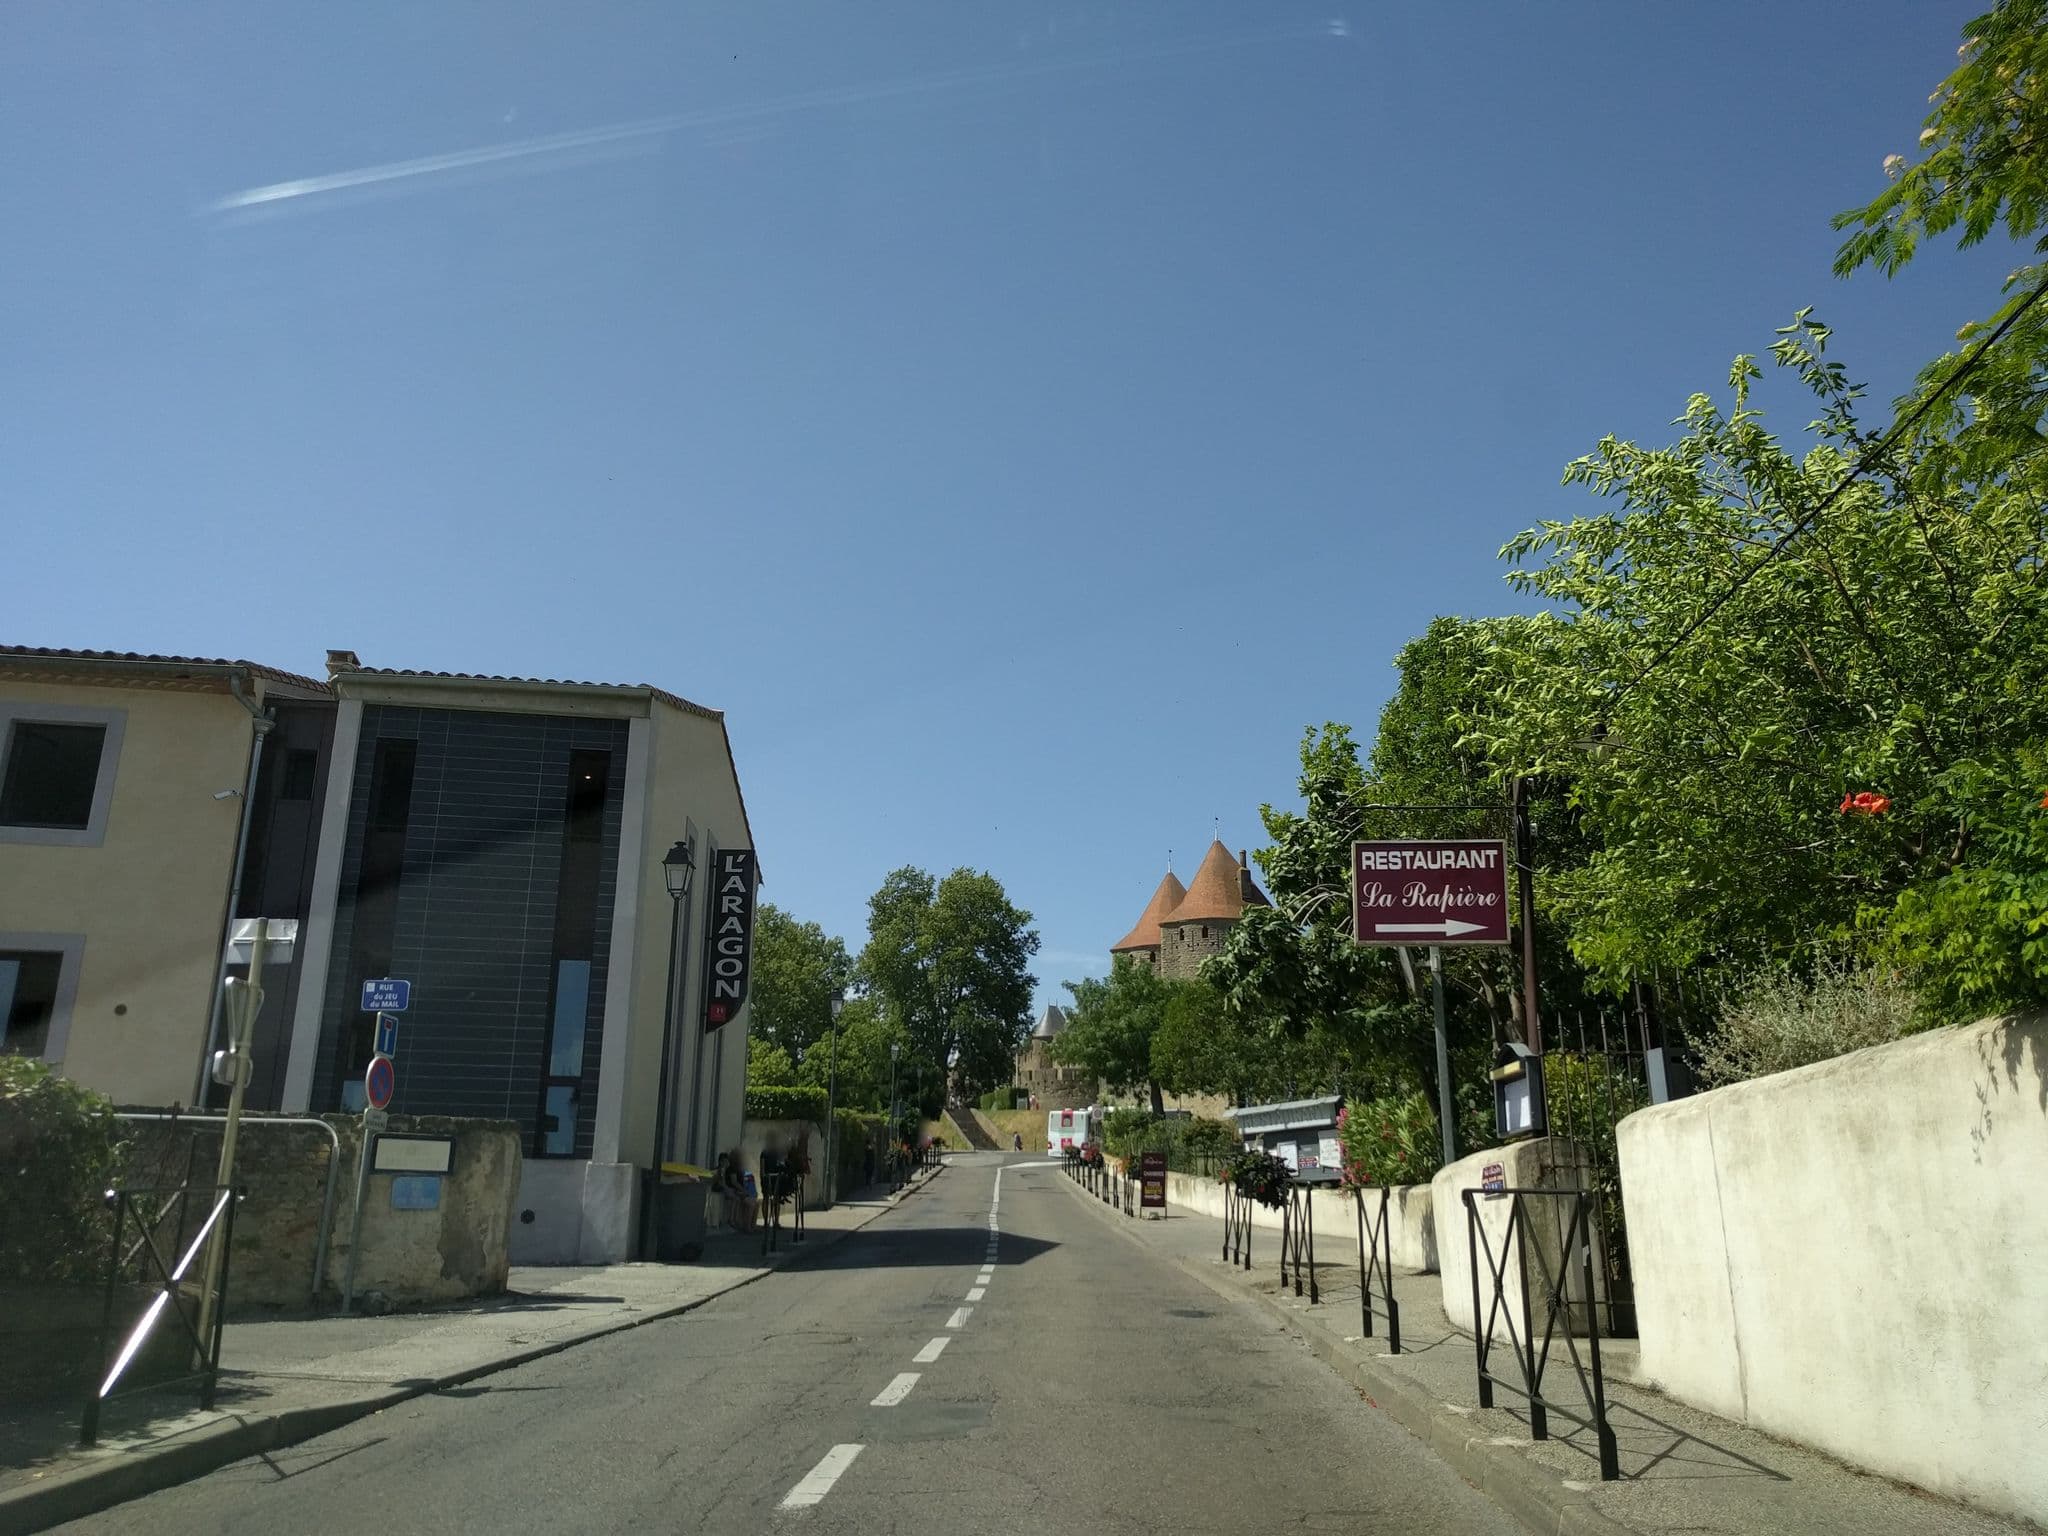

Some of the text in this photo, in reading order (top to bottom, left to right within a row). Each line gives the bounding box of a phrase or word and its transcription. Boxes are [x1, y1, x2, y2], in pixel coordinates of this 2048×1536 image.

[1361, 850, 1498, 870] RESTAURANT
[1361, 881, 1500, 913] La Rapière
[715, 854, 746, 998] L'ARAGON
[373, 992, 383, 1000] du
[379, 983, 394, 991] RUE
